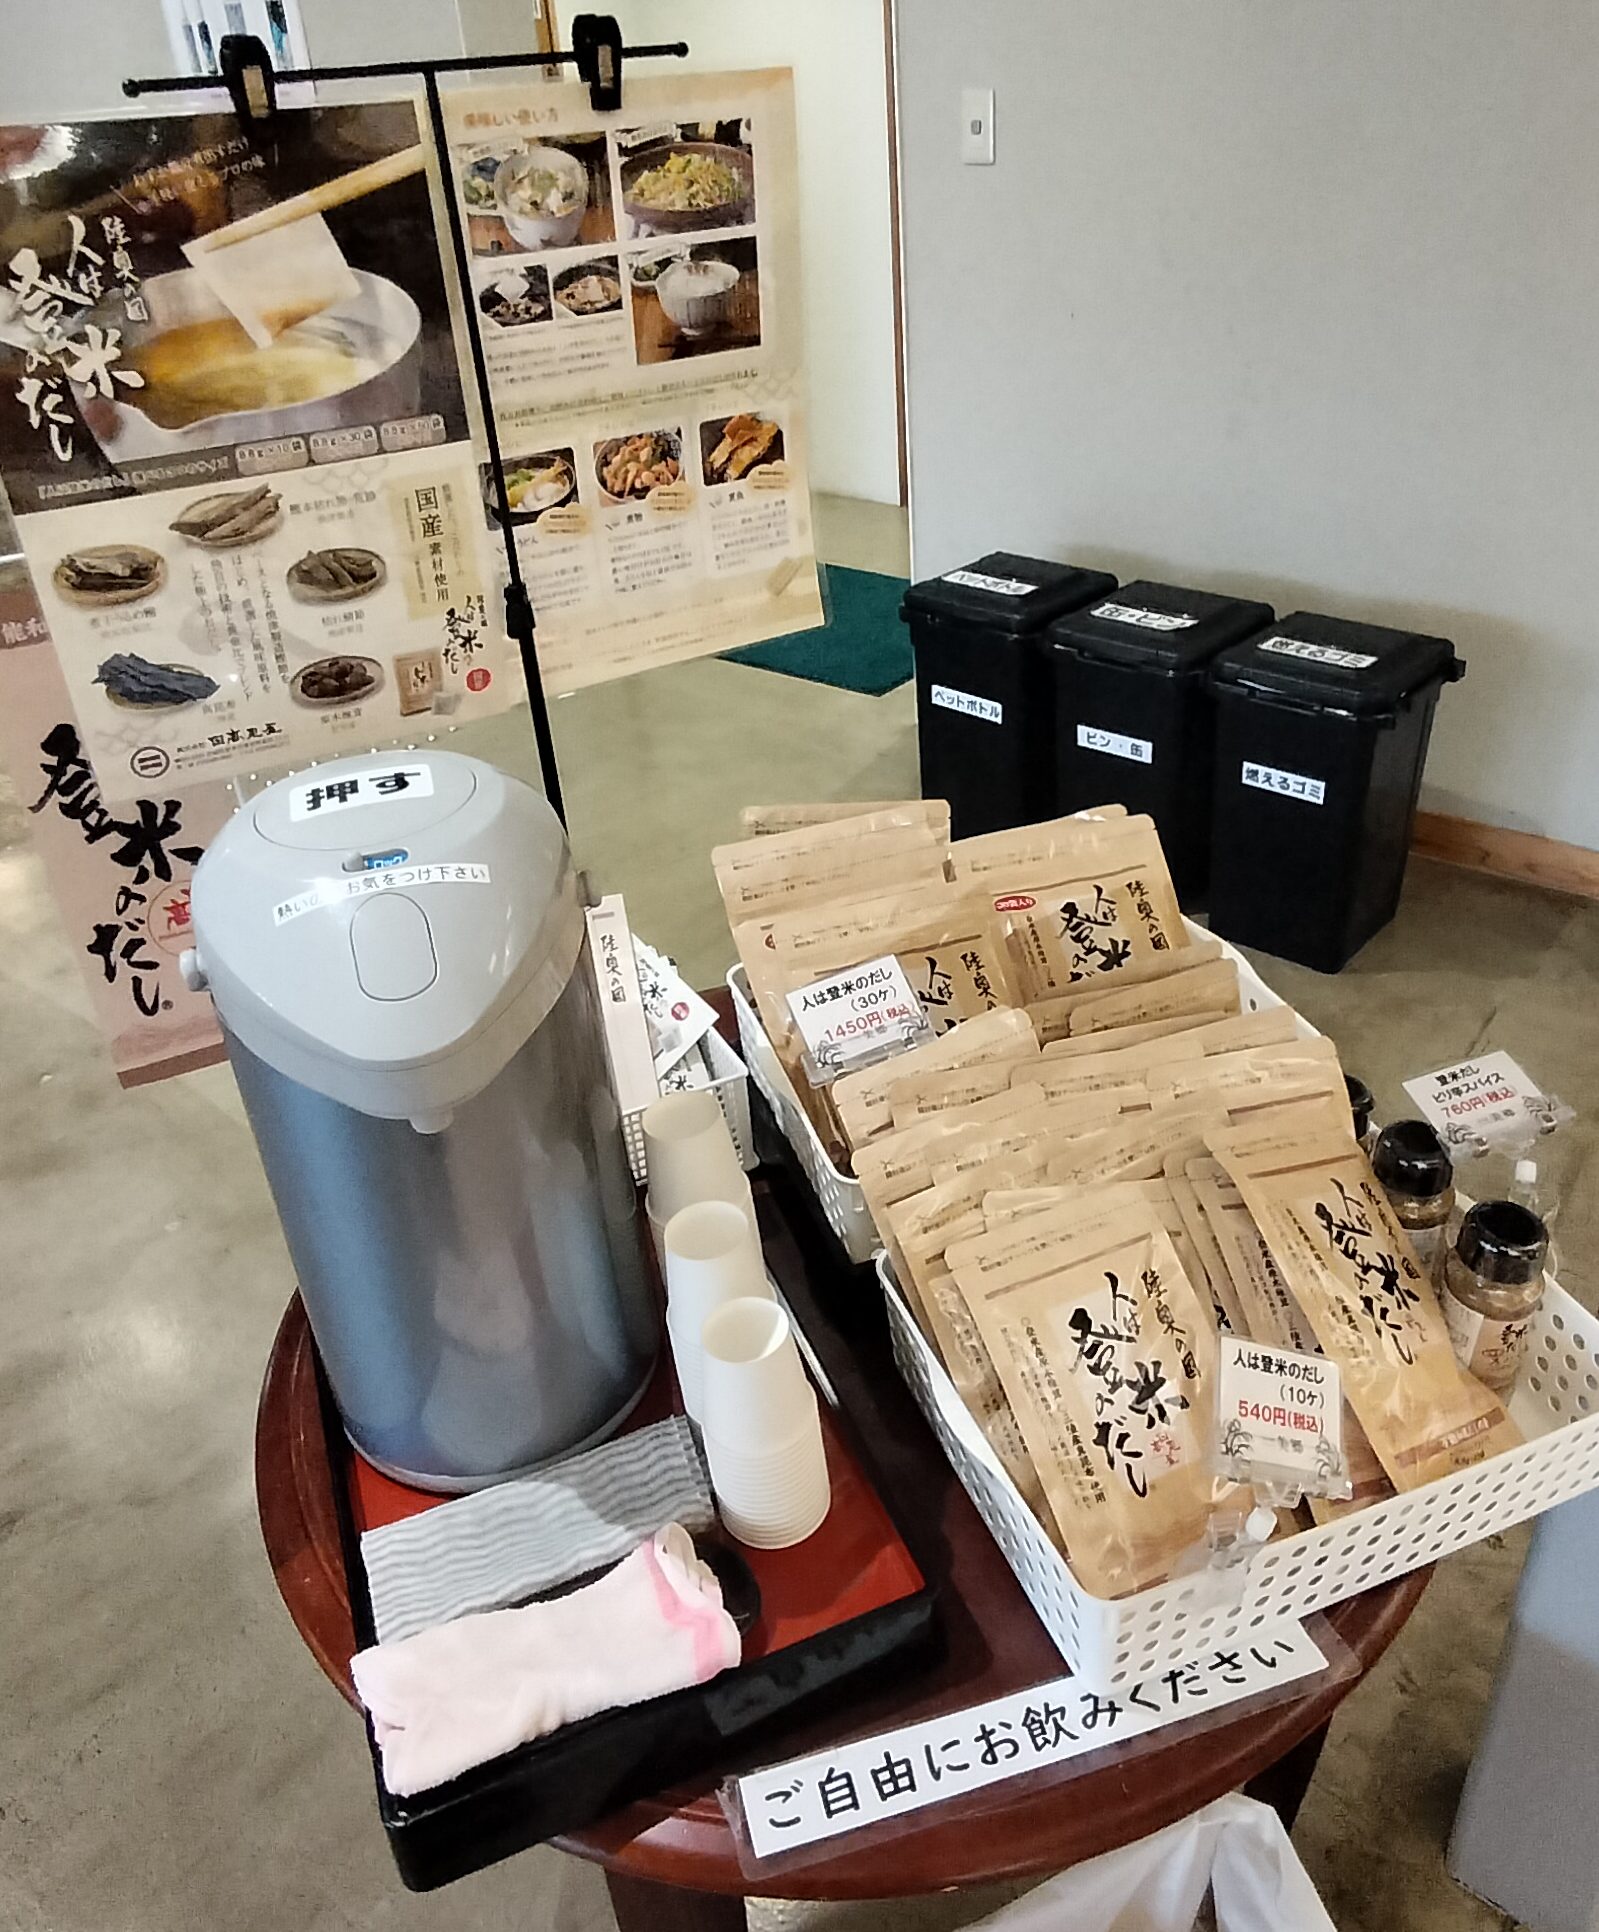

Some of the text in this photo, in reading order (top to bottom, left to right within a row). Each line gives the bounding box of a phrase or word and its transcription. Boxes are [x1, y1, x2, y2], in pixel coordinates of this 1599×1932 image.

[934, 690, 1000, 719] ペットボトル
[1086, 731, 1143, 758] ビン・缶
[305, 772, 421, 812] 押す
[1245, 767, 1321, 800] 燃えるゴミ
[277, 863, 486, 922] 熱いのお気をつけ下さい
[1125, 880, 1171, 951] 陸奥の国
[600, 934, 627, 1003] 陸奥の国
[802, 967, 893, 1012] 人は登米のだし
[824, 1003, 916, 1042] 1450円(税込)
[1440, 1086, 1518, 1118] 760円(税込)
[1141, 1268, 1202, 1380] 陸奥の国
[1233, 1347, 1325, 1384] 人は登米のだし
[1280, 1384, 1325, 1409] (10ケ)
[1238, 1400, 1324, 1437] 540円(税込)
[764, 1638, 1295, 1828] ご自由にお飲みください
